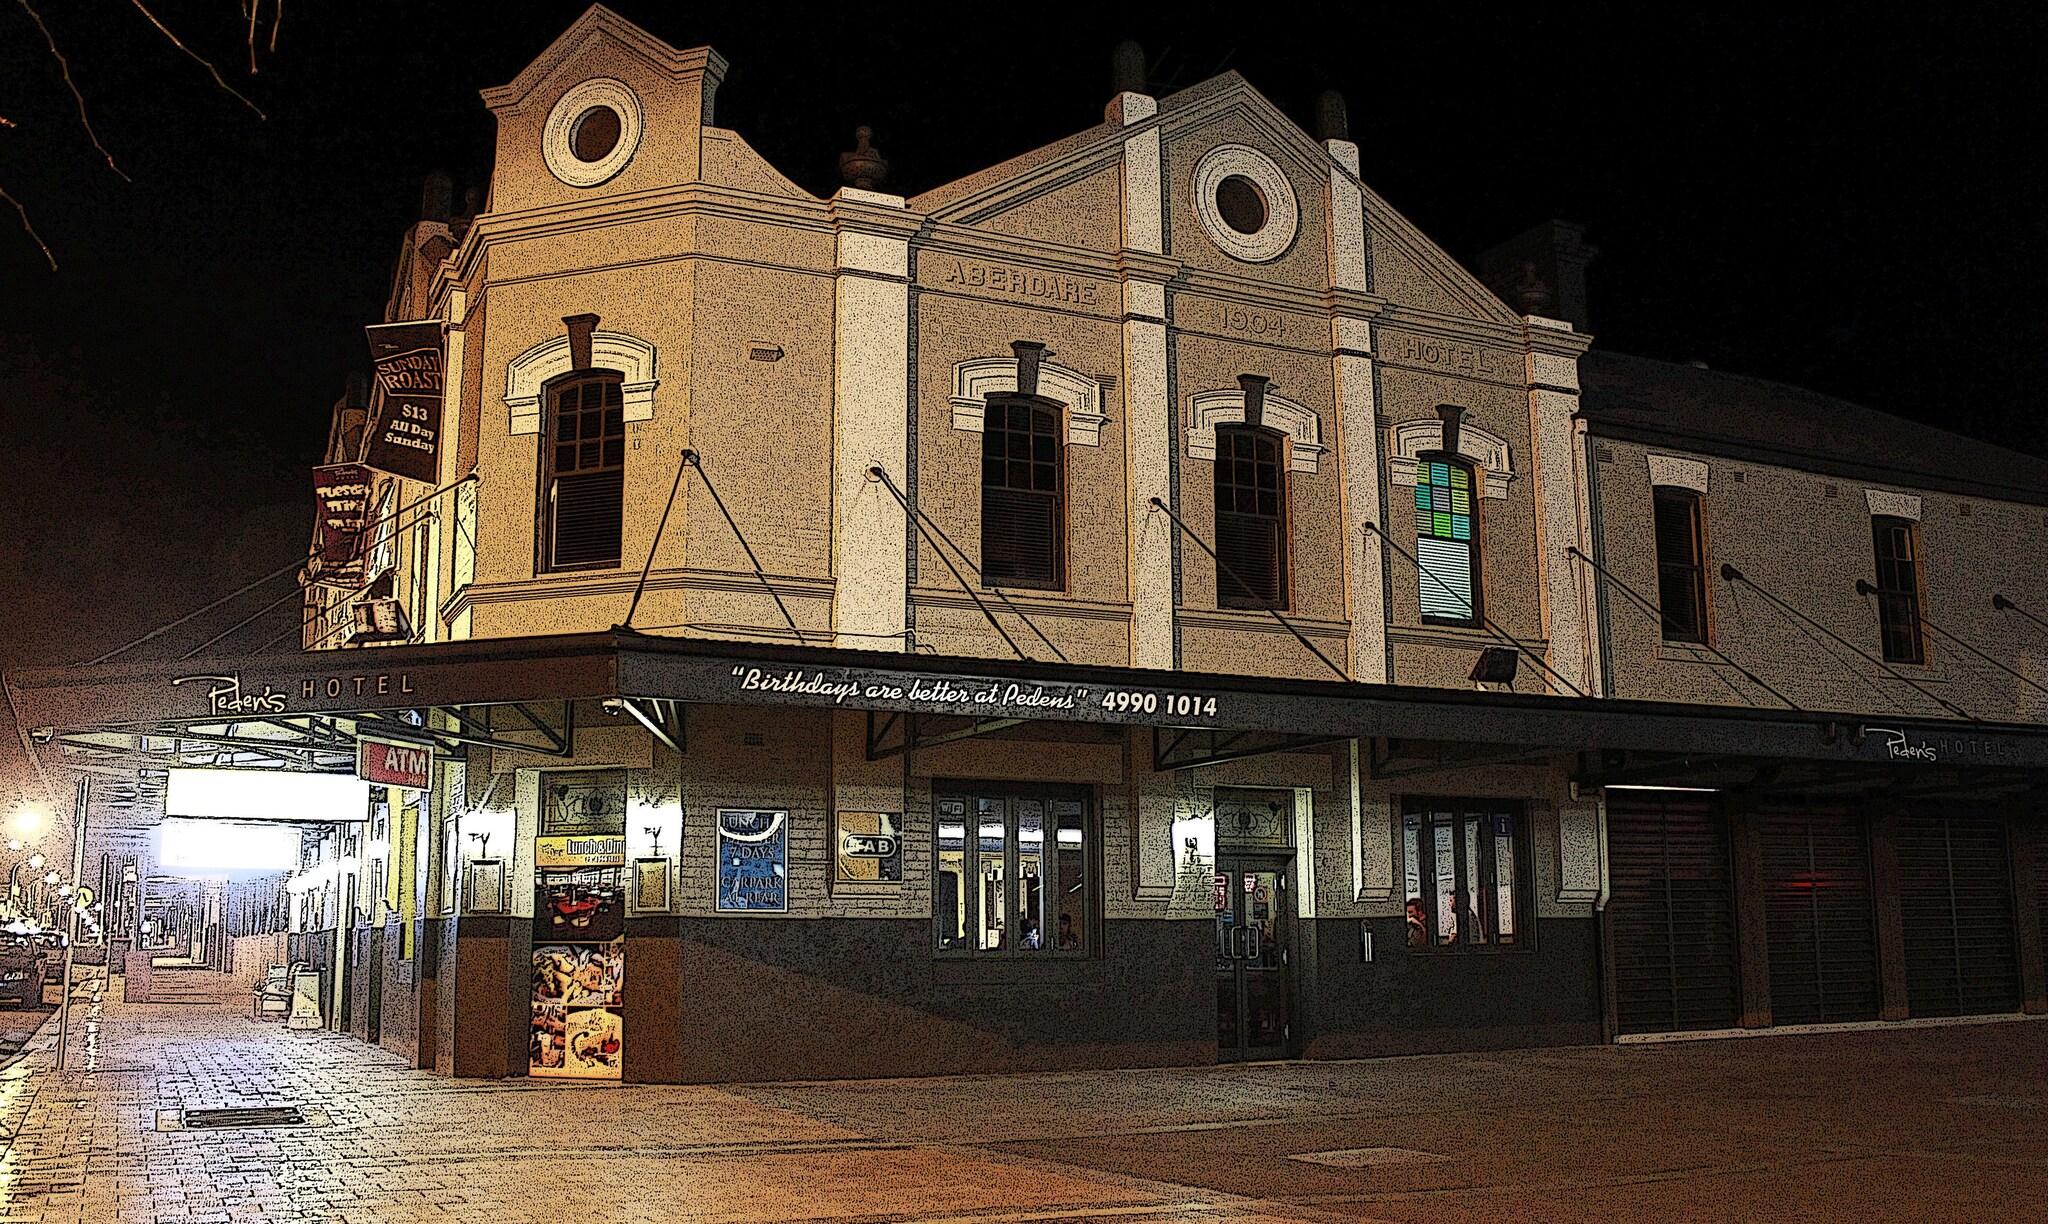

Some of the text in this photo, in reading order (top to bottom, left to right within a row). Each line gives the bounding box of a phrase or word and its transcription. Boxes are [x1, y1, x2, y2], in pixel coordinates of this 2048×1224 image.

[946, 261, 1098, 305] ABERDARE
[1222, 306, 1287, 337] 1904
[1402, 336, 1494, 373] HOTEL
[377, 356, 438, 375] SUNDAY
[384, 371, 440, 389] ROAST
[401, 403, 428, 420] $13
[390, 420, 434, 440] All Day
[384, 432, 434, 454] Sunday
[173, 669, 414, 716] Peden's HOTEL
[865, 683, 903, 699] are
[908, 678, 969, 703] better
[974, 683, 999, 704] at
[1101, 691, 1157, 713] 4990
[1166, 694, 1217, 716] 1014
[1940, 738, 2006, 756] HOTEL
[385, 746, 427, 775] ATM
[567, 838, 596, 855] Lunch
[597, 840, 606, 854] &
[731, 846, 775, 859] 7 DAYS
